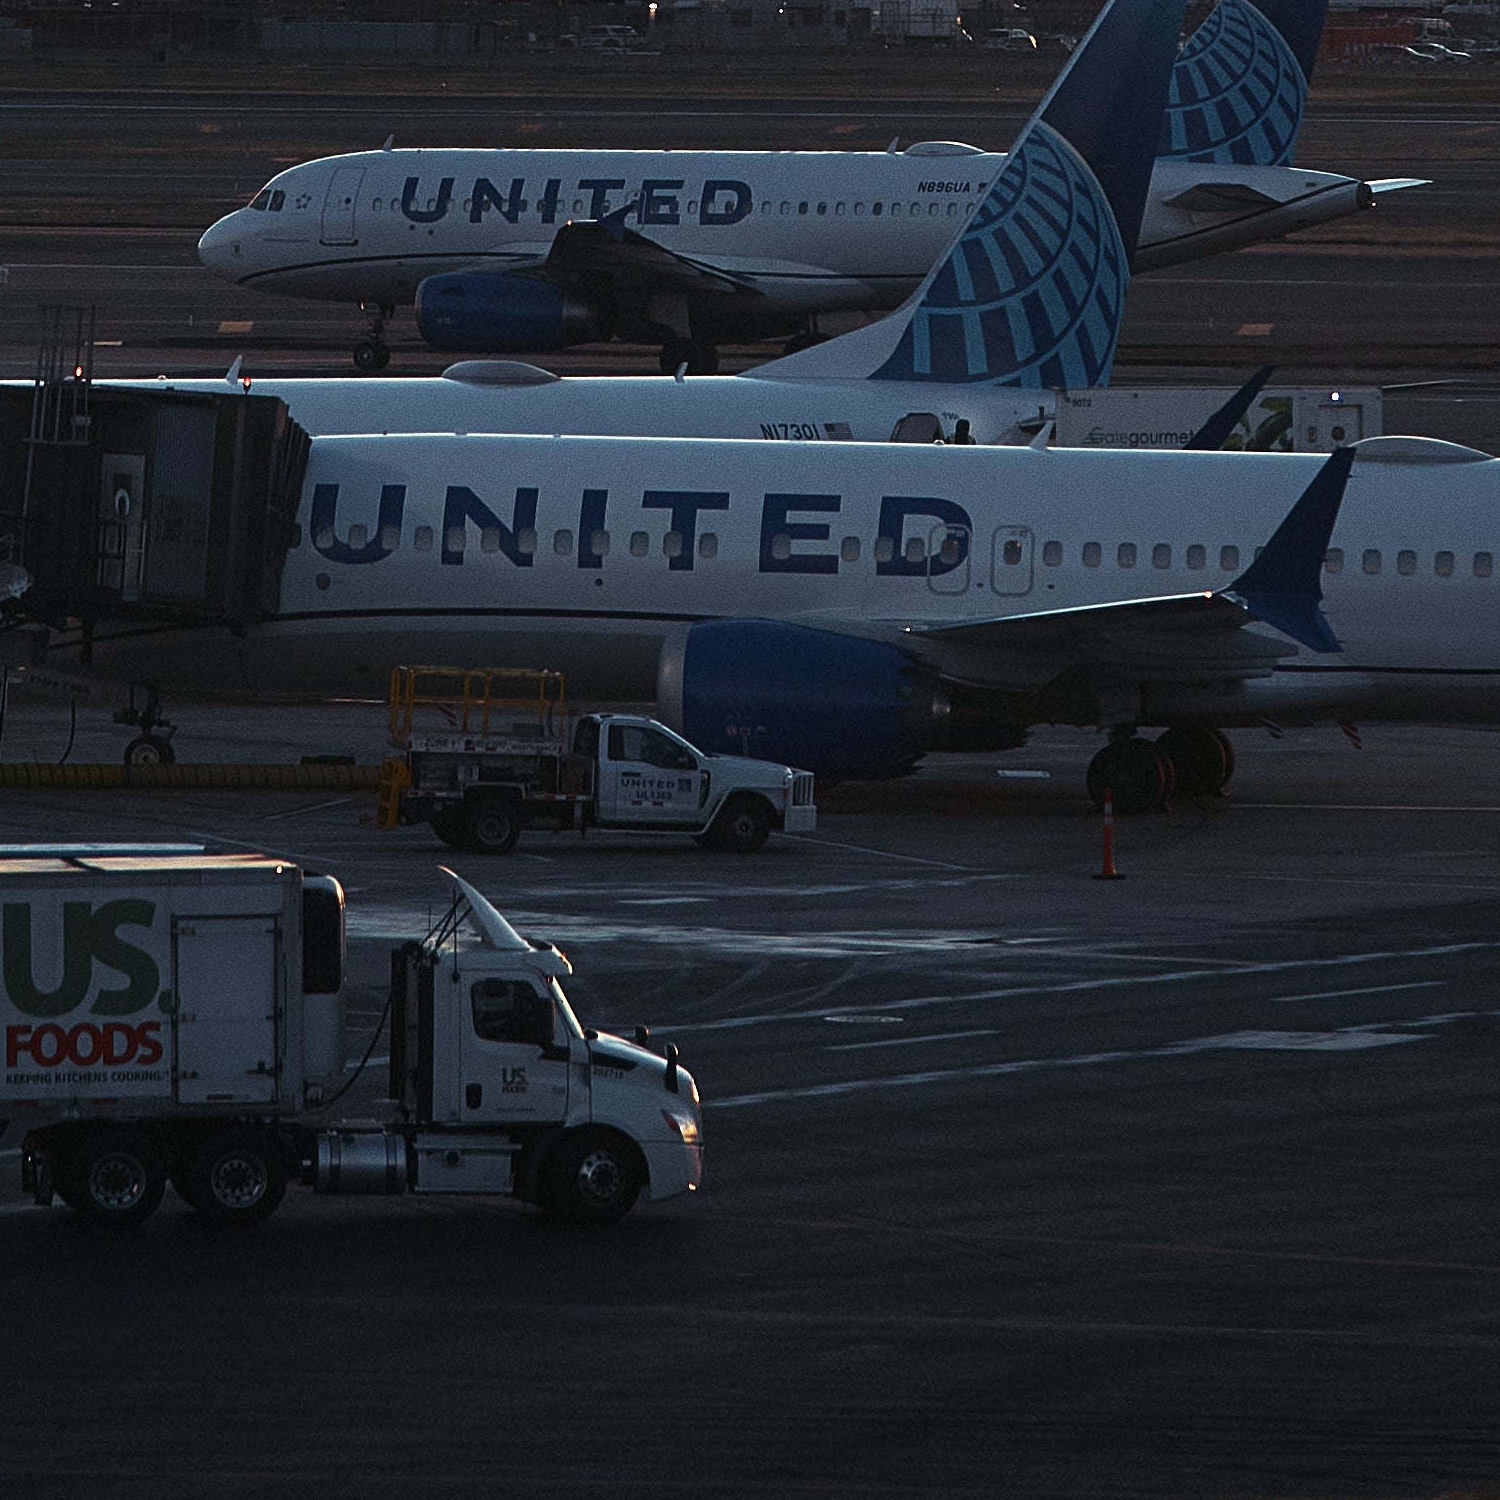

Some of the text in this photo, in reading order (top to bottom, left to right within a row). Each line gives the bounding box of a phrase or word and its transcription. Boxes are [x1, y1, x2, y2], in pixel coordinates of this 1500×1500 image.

[401, 177, 753, 226] UNITED
[917, 181, 971, 193] N896UA
[760, 422, 821, 441] N17301
[309, 483, 973, 577] UNITED
[620, 779, 675, 789] UNITED
[3, 898, 181, 1018] US.
[6, 1022, 164, 1068] FOODS
[6, 1073, 52, 1084] KEEPING
[55, 1072, 109, 1083] KITCHENS
